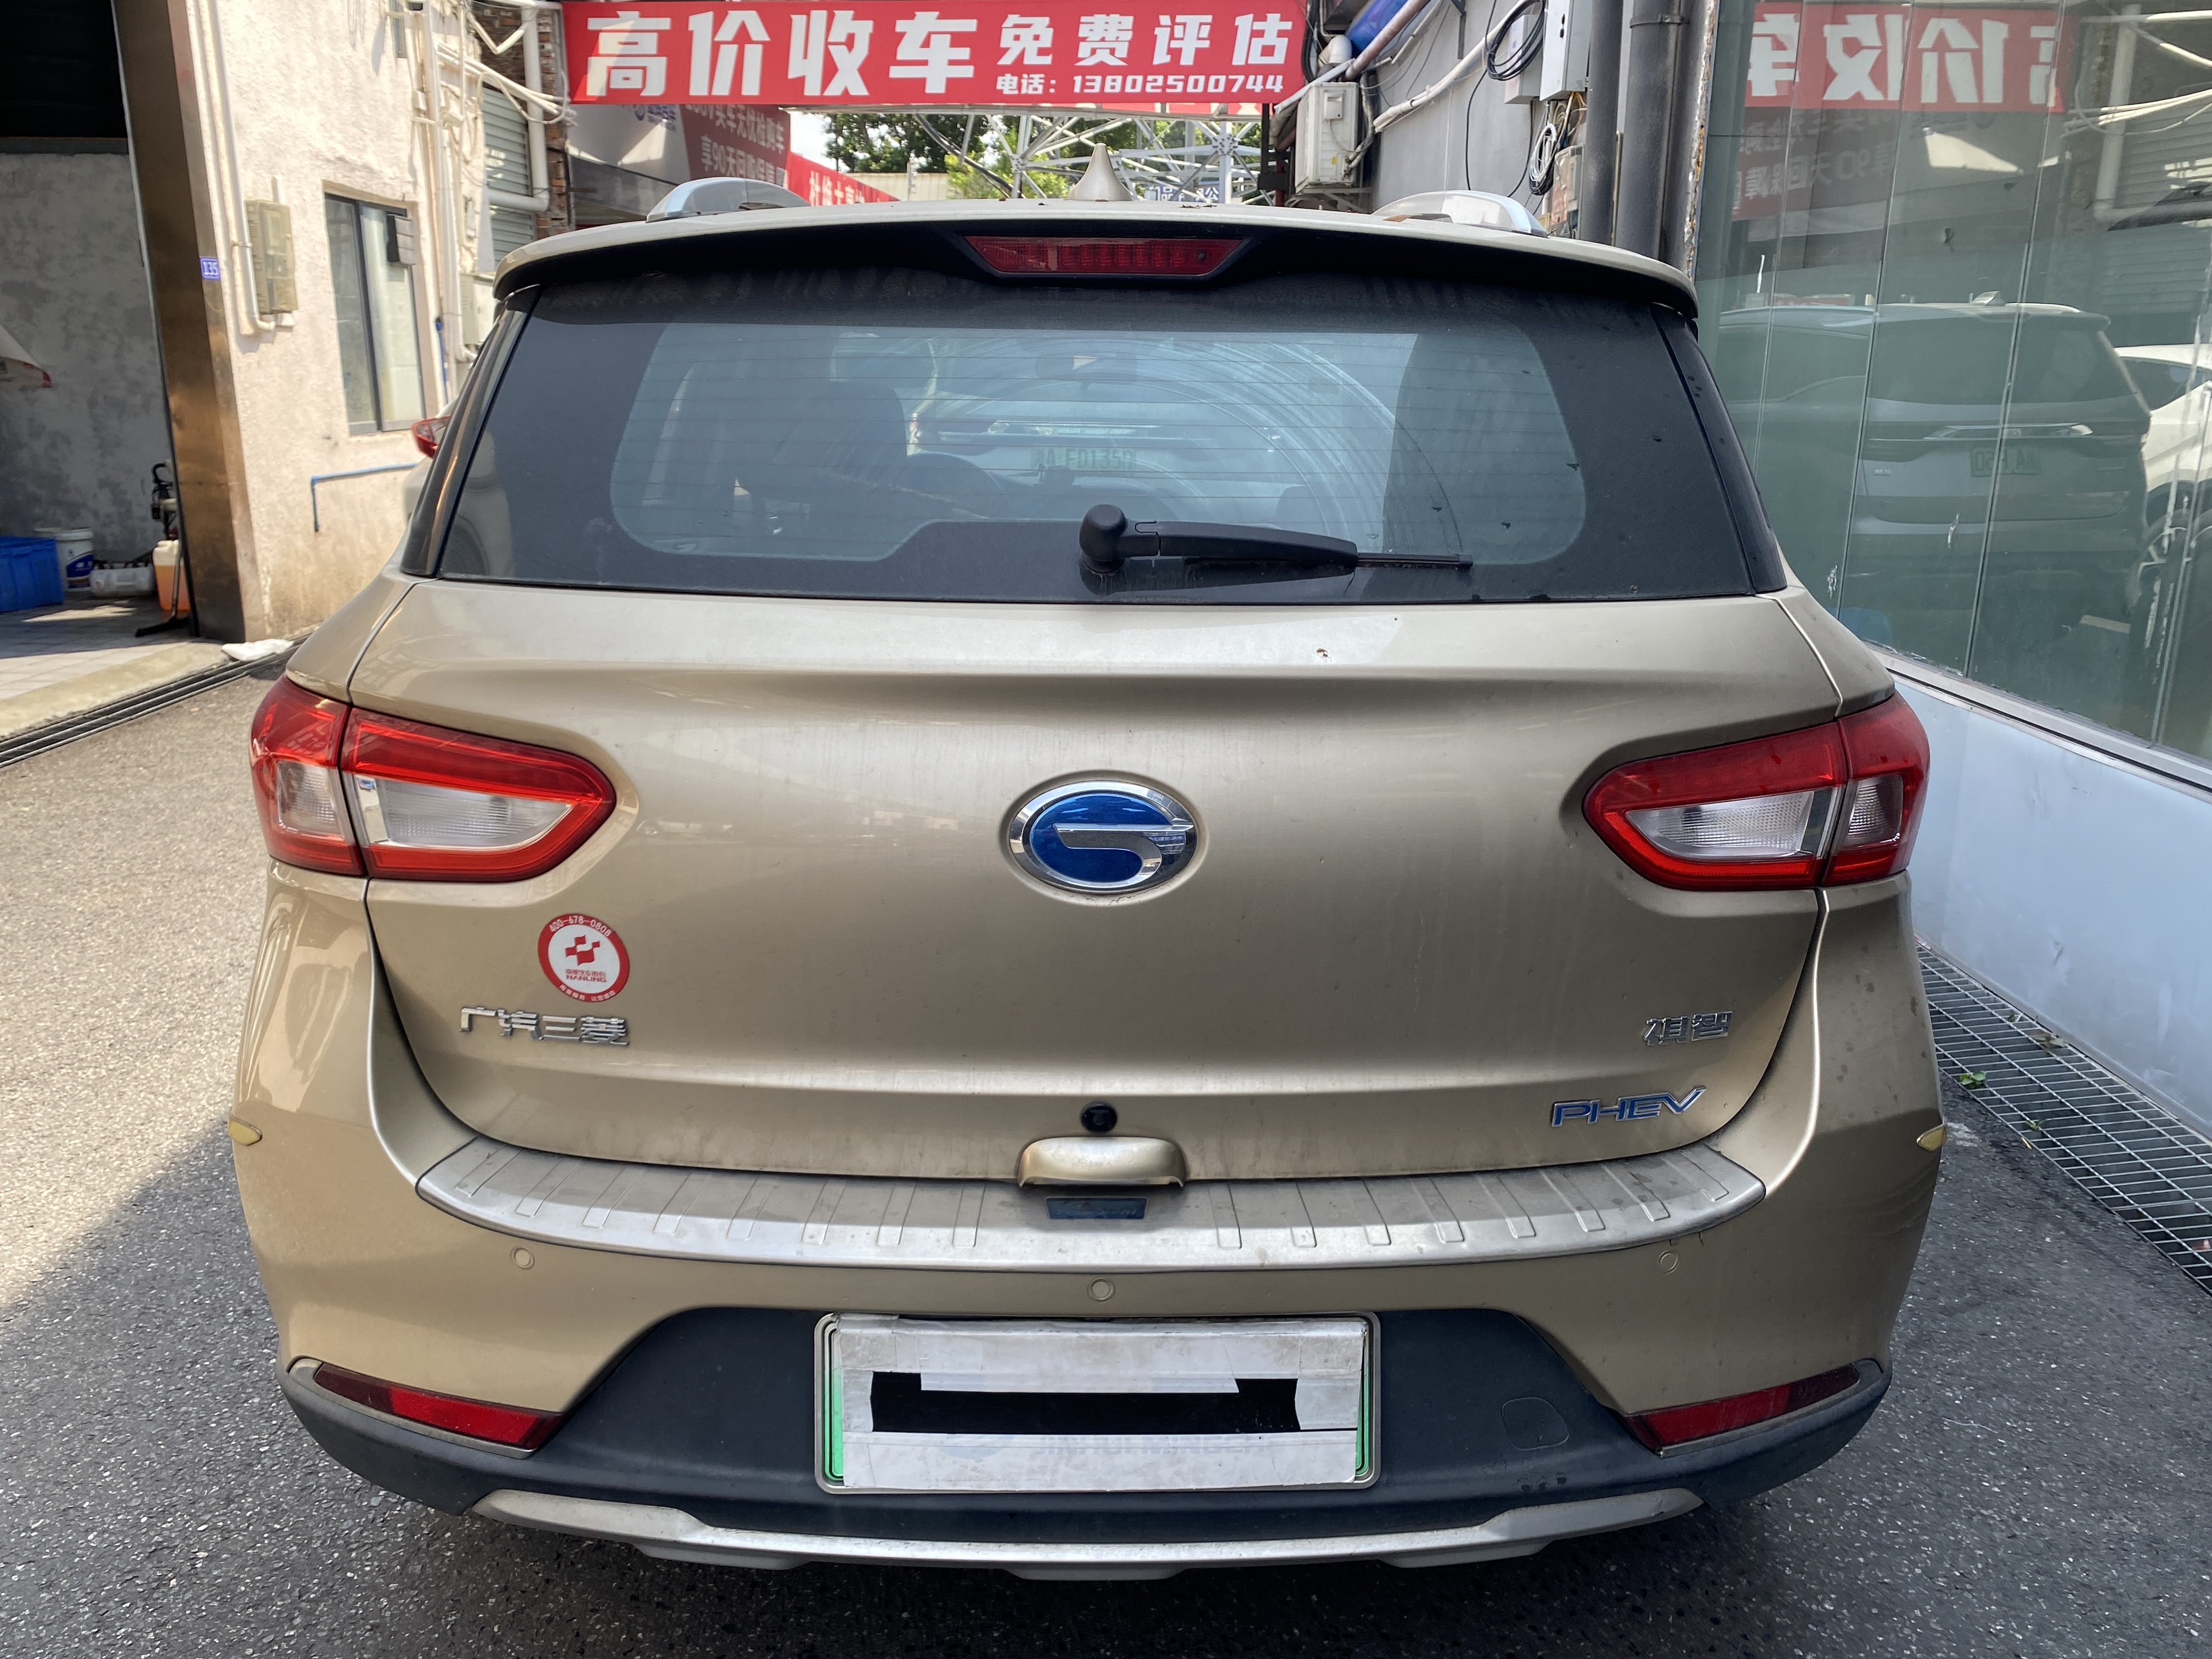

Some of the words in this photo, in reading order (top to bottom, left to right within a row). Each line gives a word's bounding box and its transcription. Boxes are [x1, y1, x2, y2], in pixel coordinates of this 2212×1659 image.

[586, 10, 978, 97] 高价收车
[996, 13, 1293, 66] 免费评估
[1073, 74, 1284, 94] 13802500744
[202, 261, 219, 276] 135
[549, 915, 612, 938] 400-678-0808
[566, 975, 607, 983] NANLING
[1643, 1011, 1733, 1046] 祺智
[1551, 1086, 1707, 1127] PHEV
